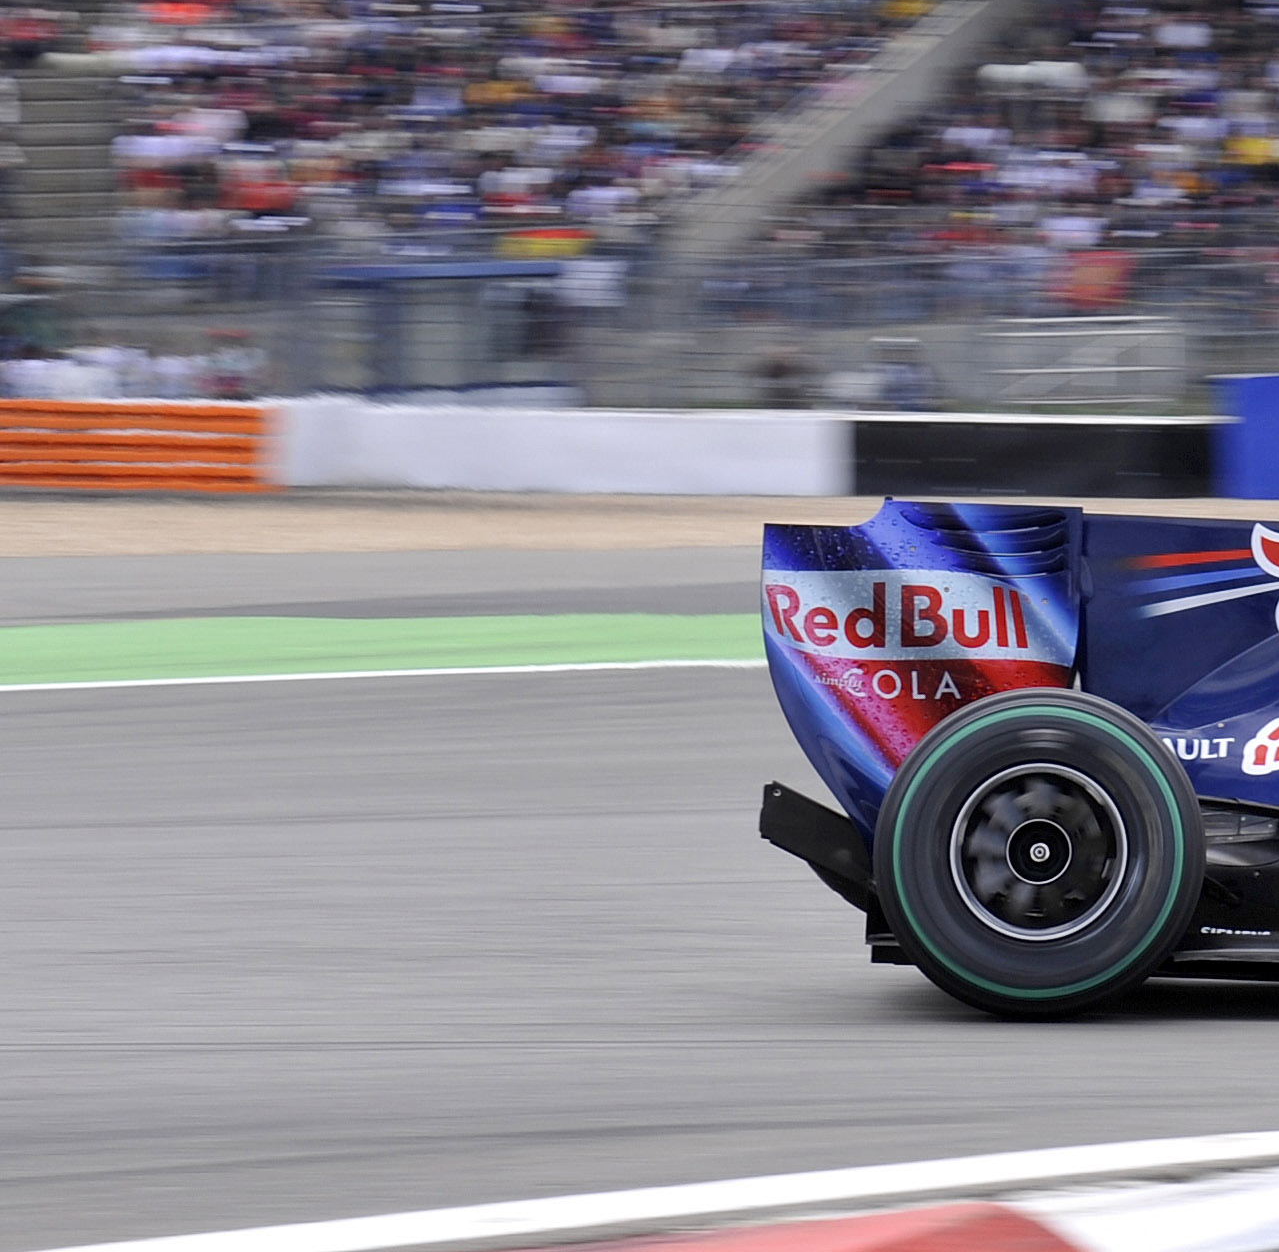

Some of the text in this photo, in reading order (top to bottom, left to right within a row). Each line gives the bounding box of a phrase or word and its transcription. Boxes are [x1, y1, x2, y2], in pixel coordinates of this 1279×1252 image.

[765, 582, 1028, 649] Red Bull
[842, 667, 961, 700] COLA
